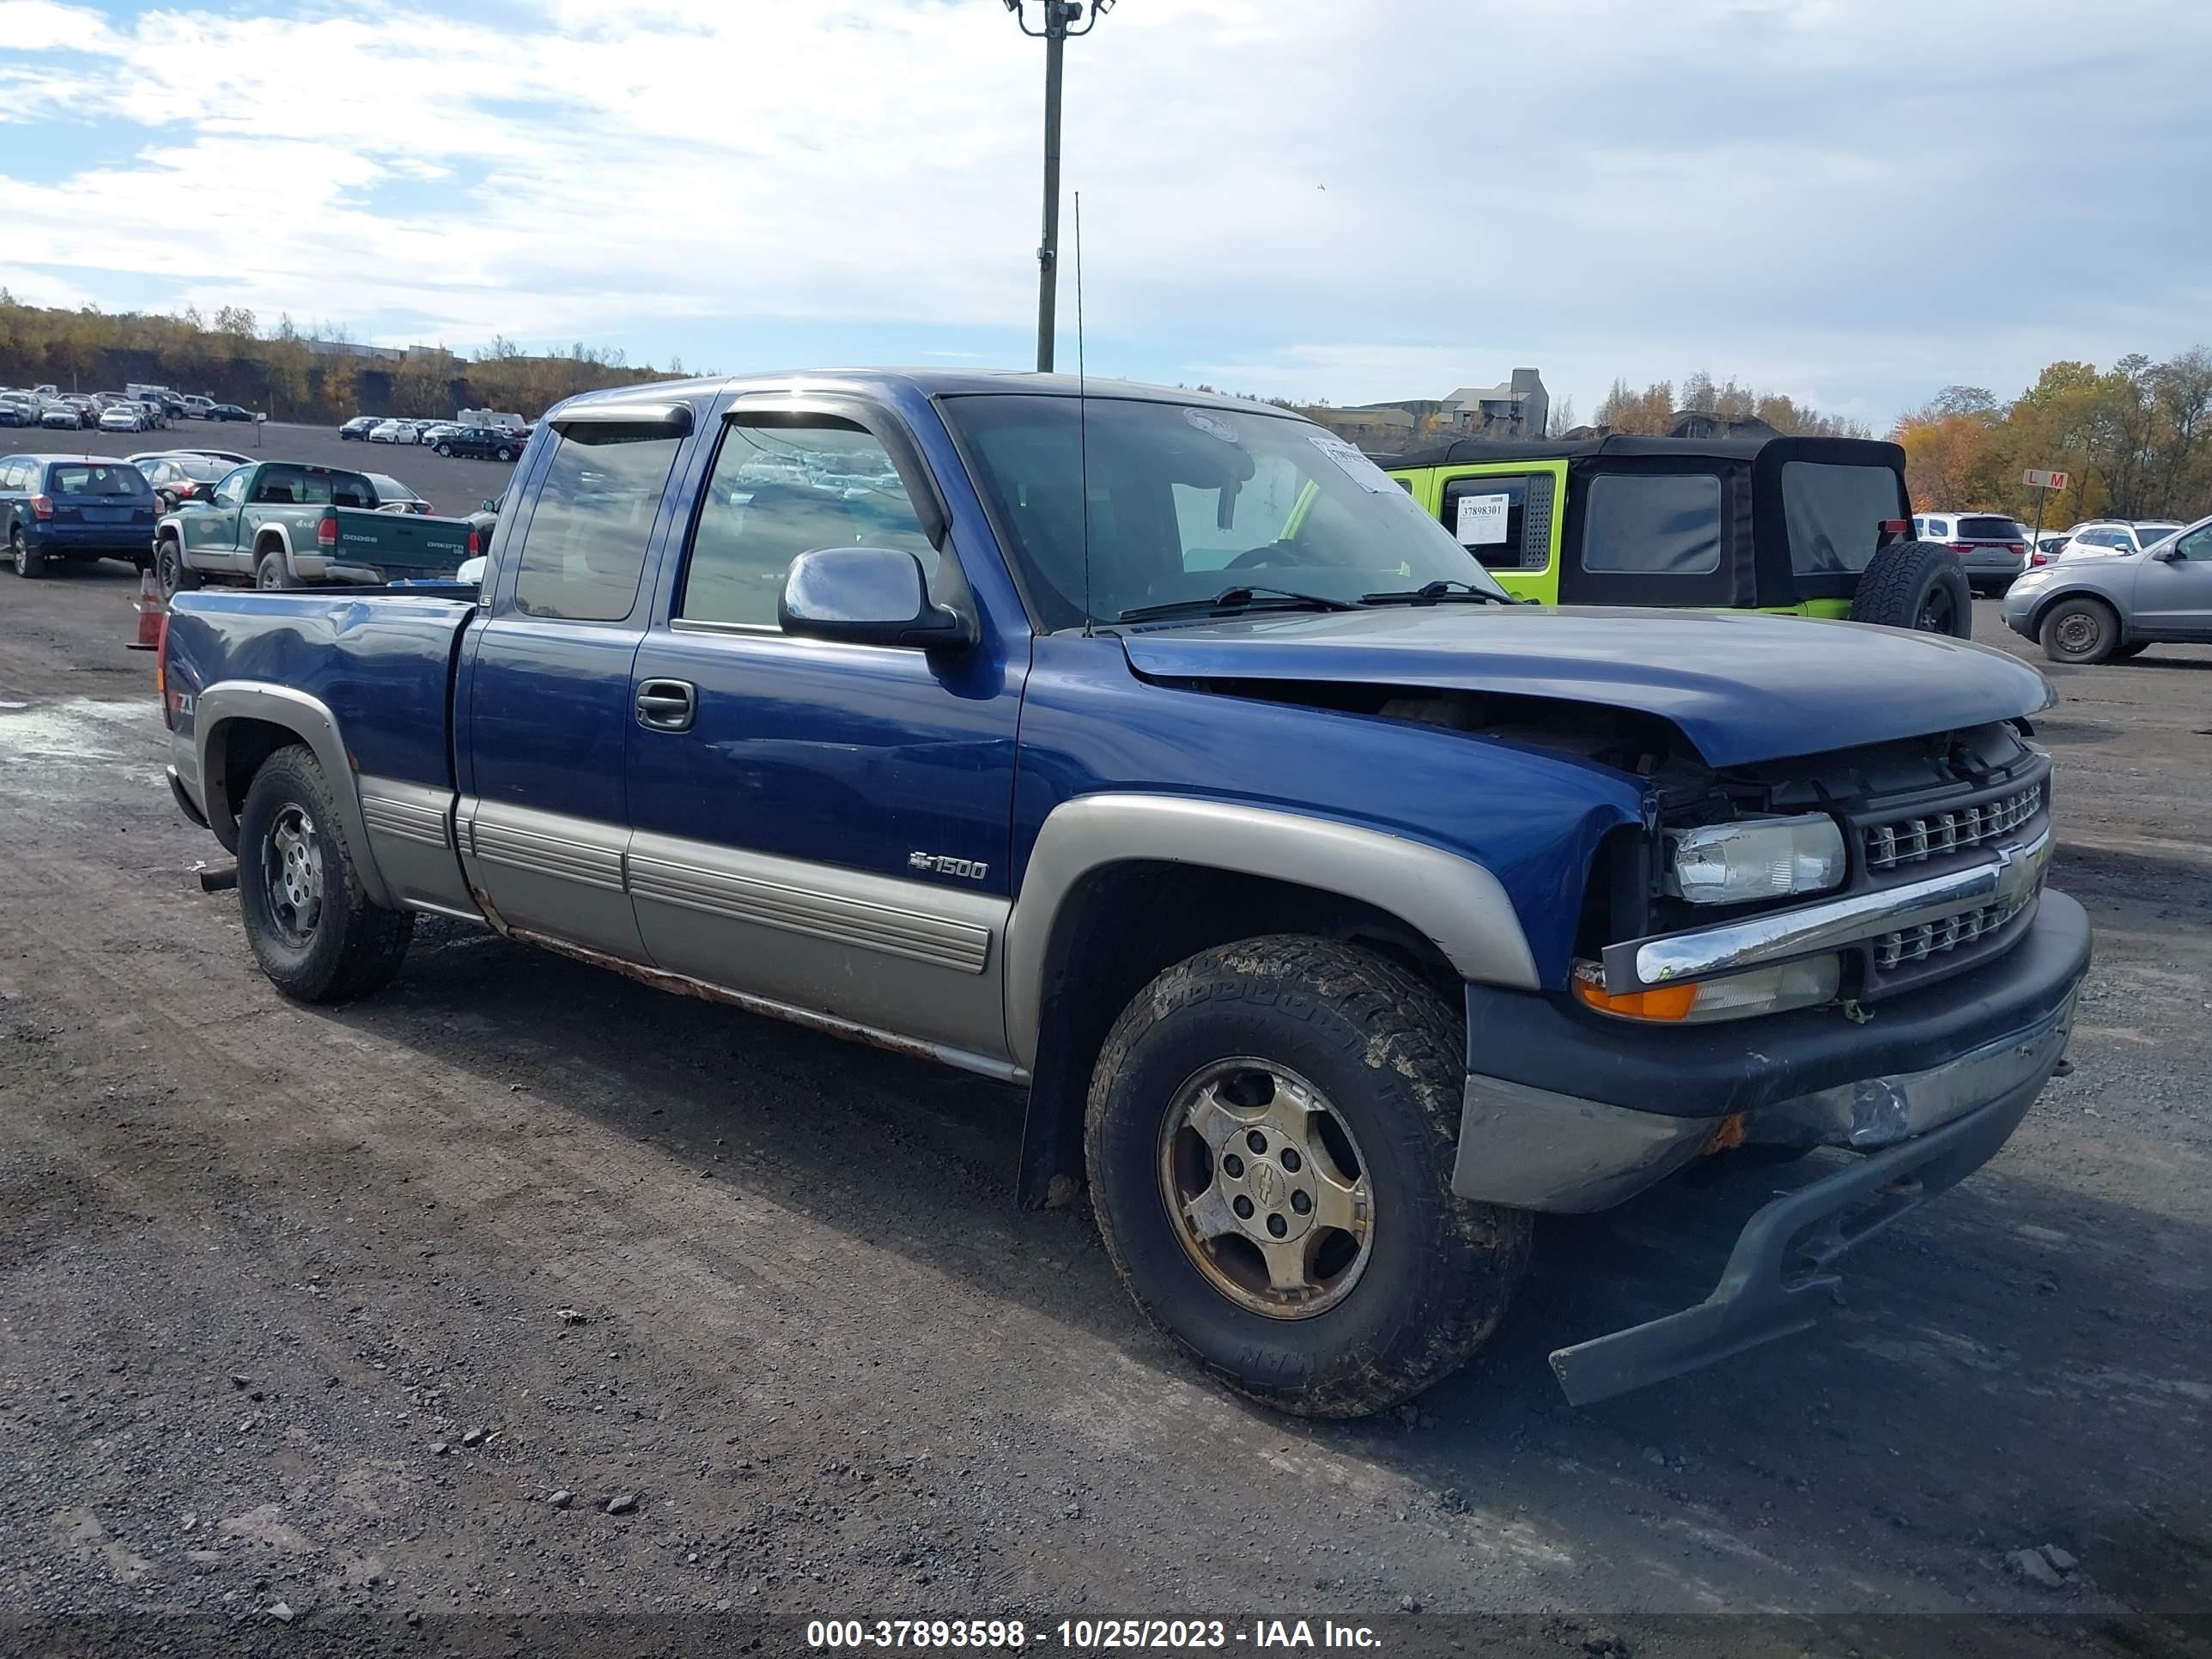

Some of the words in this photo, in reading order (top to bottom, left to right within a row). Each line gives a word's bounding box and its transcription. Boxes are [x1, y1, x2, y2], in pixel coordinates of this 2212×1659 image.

[2029, 471, 2038, 483] L
[2051, 473, 2064, 487] M
[1462, 505, 1501, 516] 37898301
[343, 533, 378, 543] DODGE
[935, 856, 988, 879] 1500
